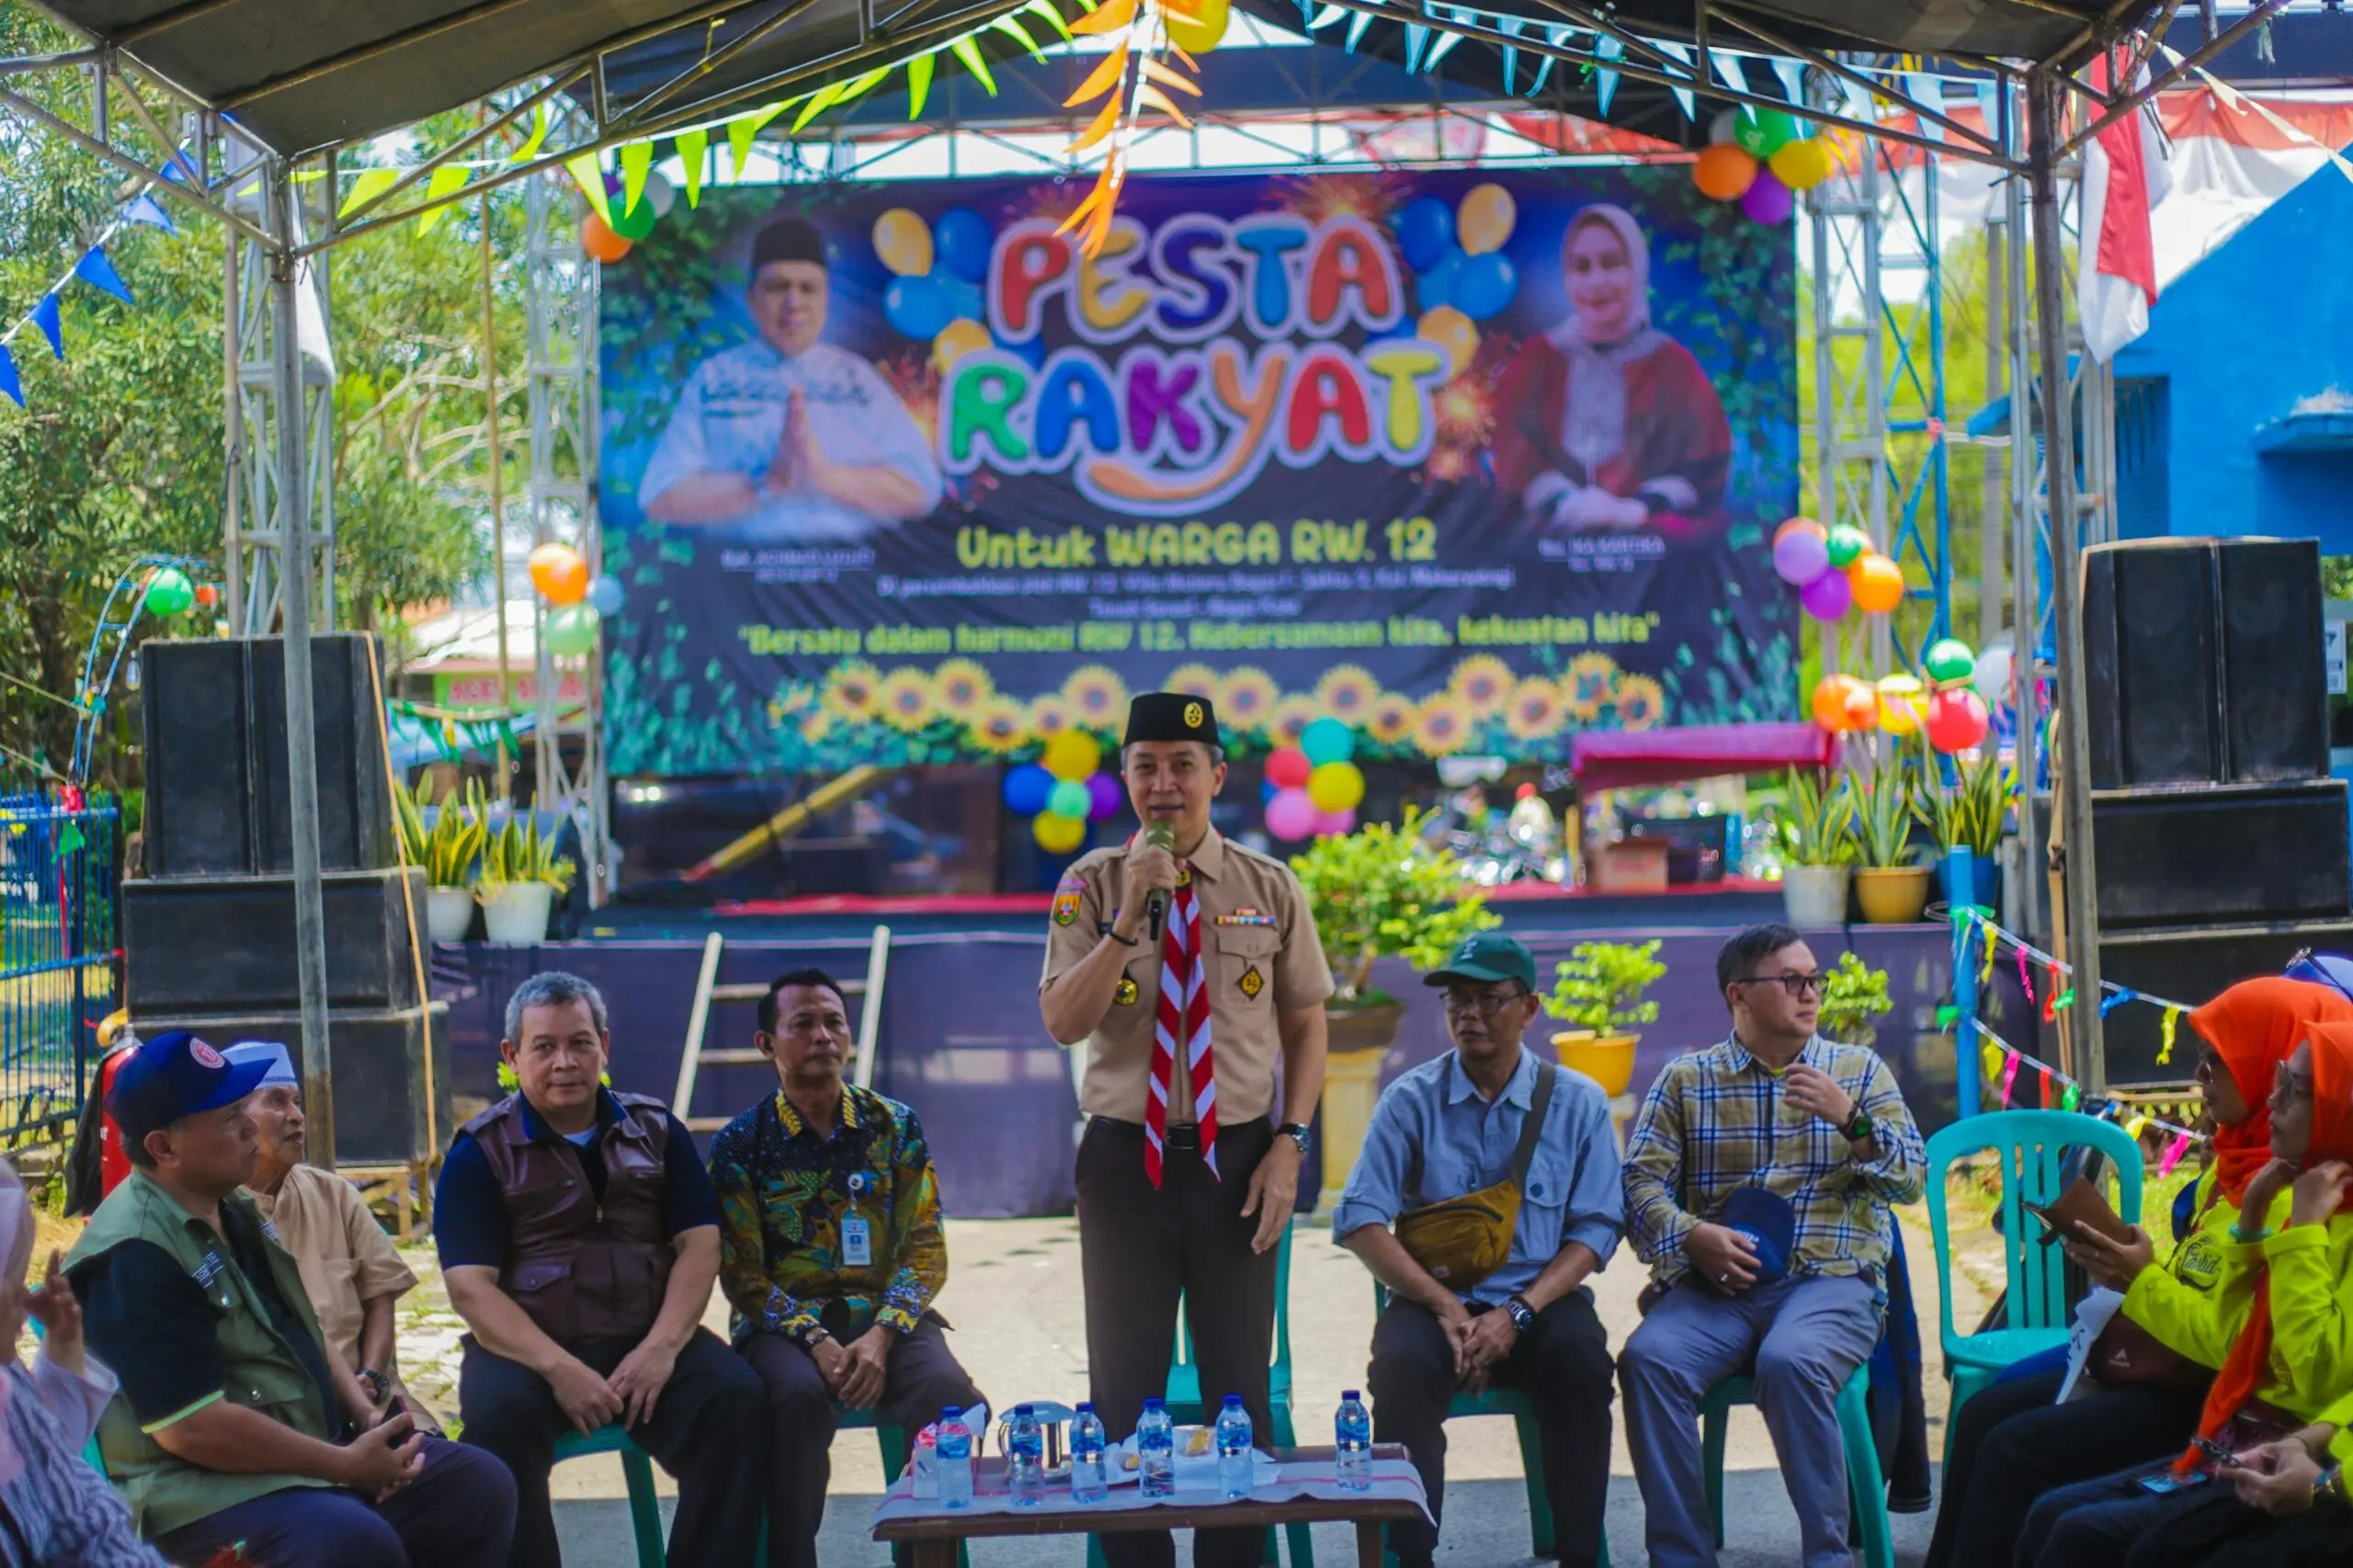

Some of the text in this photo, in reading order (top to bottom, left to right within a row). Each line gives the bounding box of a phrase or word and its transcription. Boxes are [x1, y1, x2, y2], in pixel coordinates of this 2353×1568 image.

[991, 215, 1403, 341] PESTA
[939, 340, 1449, 514] RAKYAT
[958, 516, 1437, 568] Untuk WARGA RW. 12
[866, 623, 951, 653] dalam
[1458, 612, 1588, 644] kekuatan
